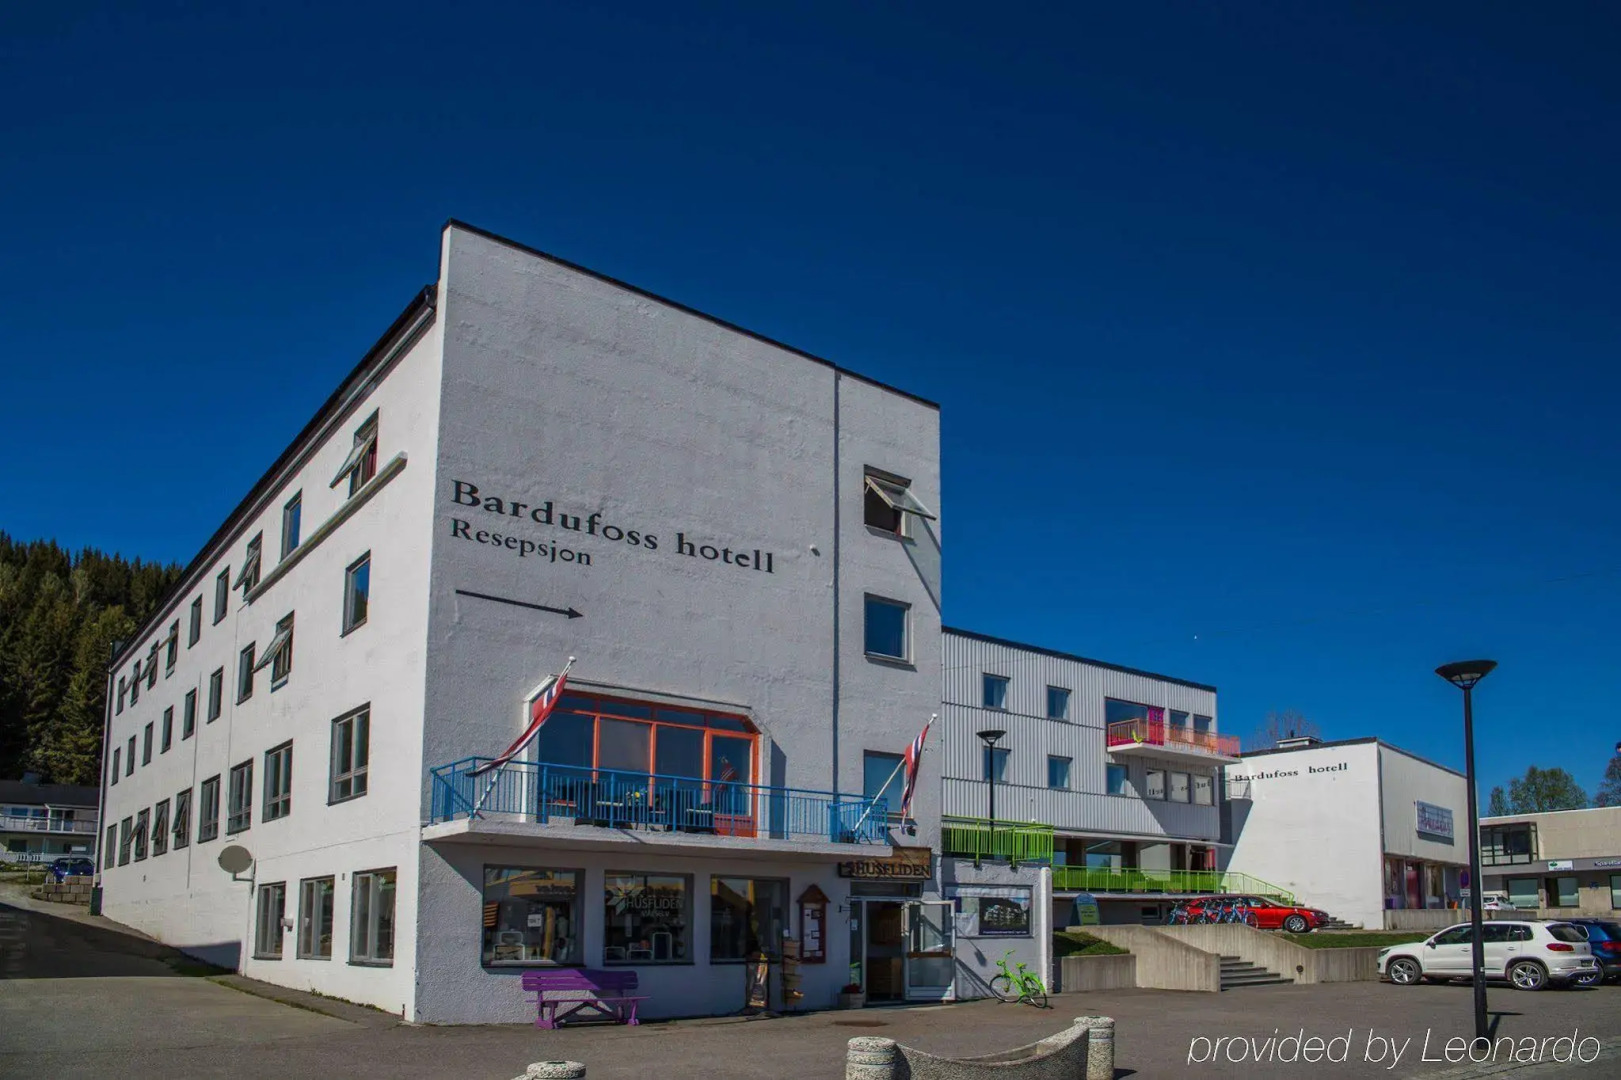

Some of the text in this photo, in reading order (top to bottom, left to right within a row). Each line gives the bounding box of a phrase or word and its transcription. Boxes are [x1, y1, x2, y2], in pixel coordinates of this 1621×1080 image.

[451, 479, 775, 574] Bardufoss hotell
[450, 518, 593, 566] Resepsjon
[1235, 762, 1348, 782] Bardufoss hotell
[854, 861, 931, 877] HUSFLIDEN
[626, 897, 684, 909] HUSFLIDEN
